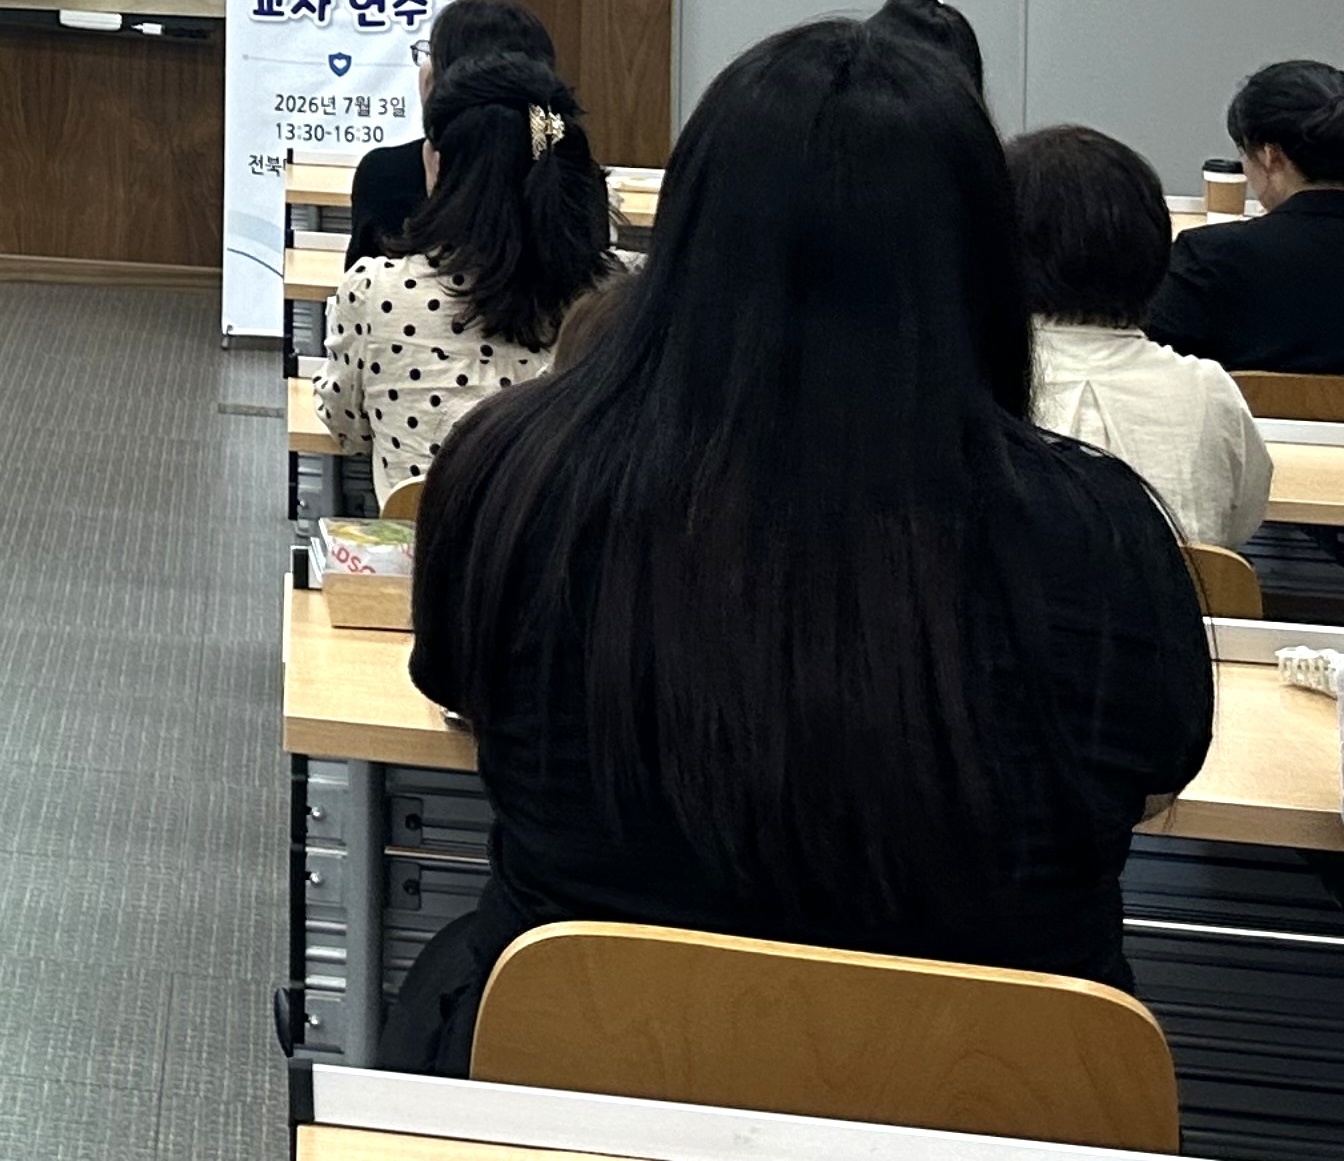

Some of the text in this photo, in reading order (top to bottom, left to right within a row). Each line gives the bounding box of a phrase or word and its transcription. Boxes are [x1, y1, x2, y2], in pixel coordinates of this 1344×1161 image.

[274, 94, 407, 118] 2026년 7월 3일
[248, 154, 287, 177] 전북
